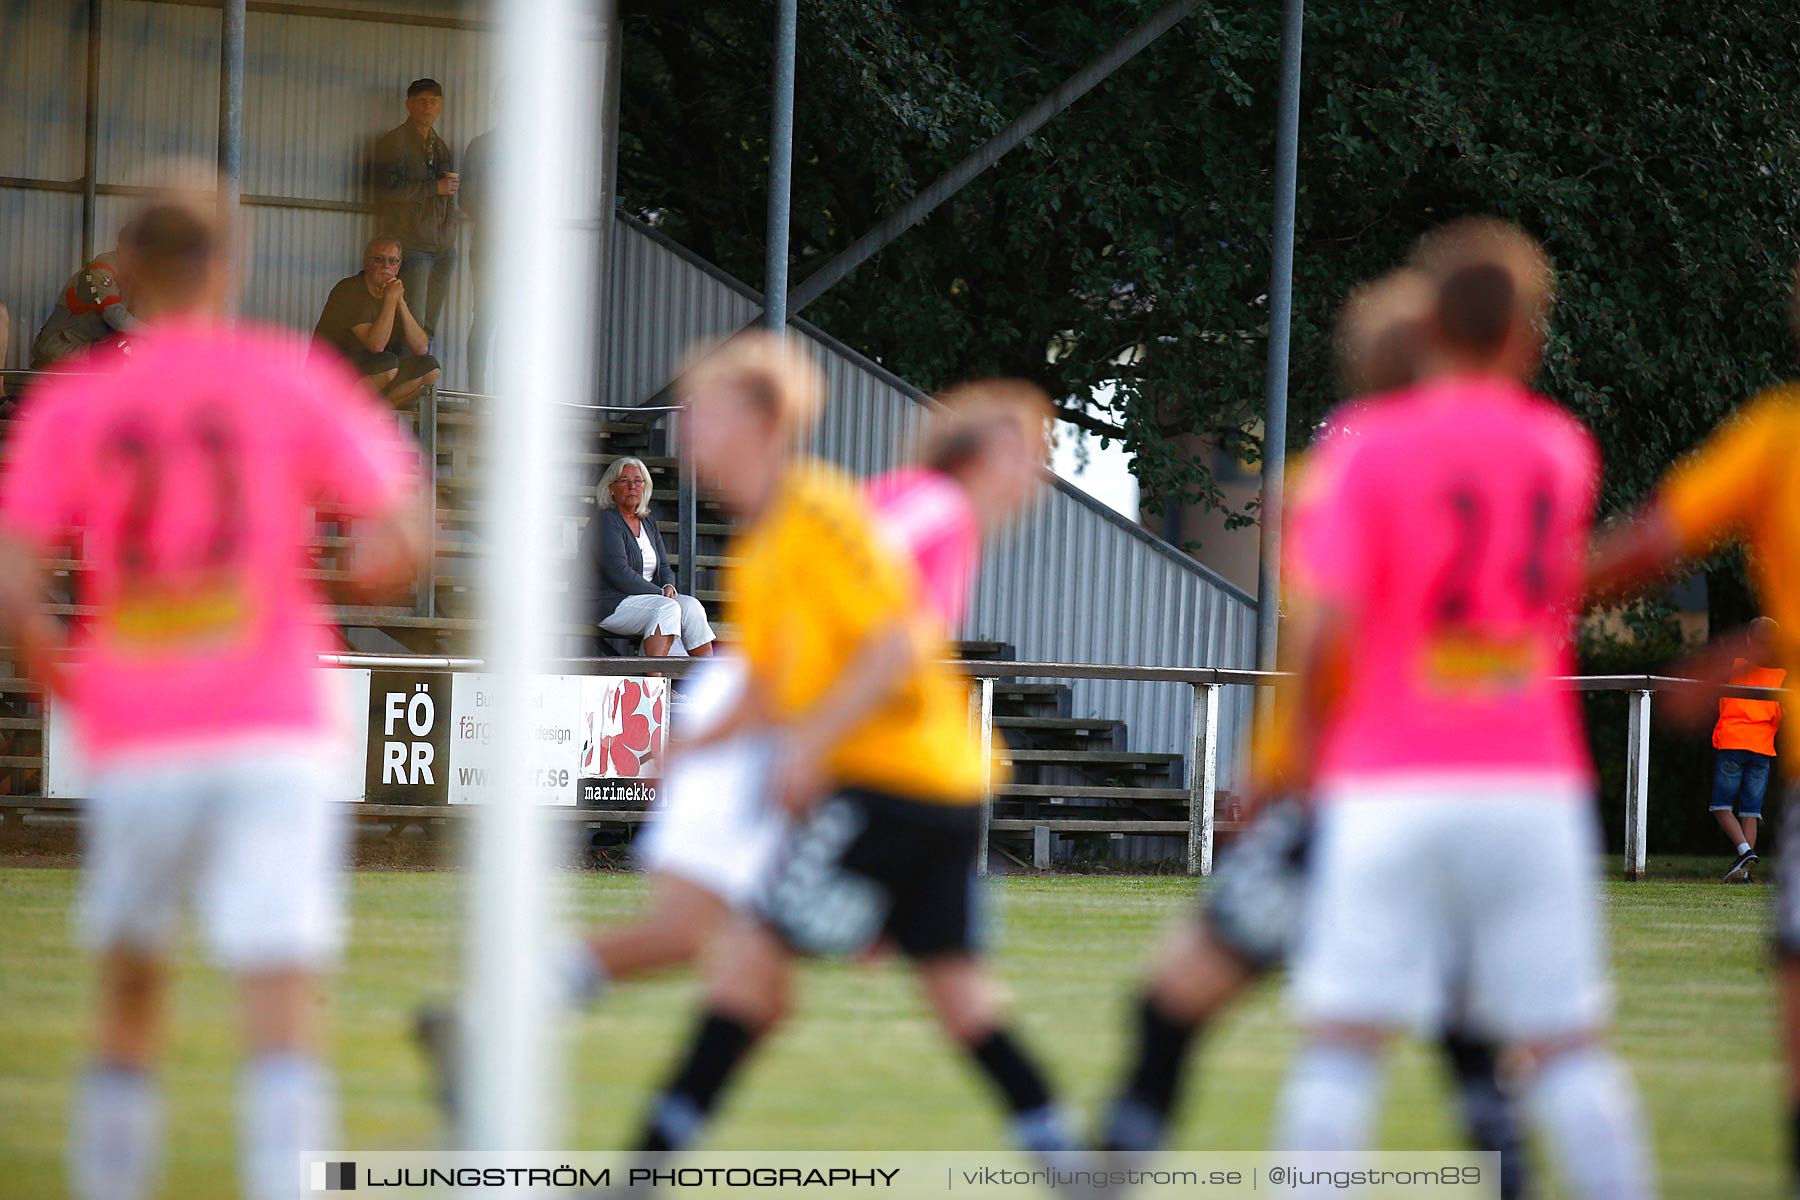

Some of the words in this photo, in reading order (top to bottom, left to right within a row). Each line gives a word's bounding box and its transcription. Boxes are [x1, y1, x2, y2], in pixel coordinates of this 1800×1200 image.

[384, 683, 435, 737] FÖ
[382, 741, 435, 785] RR
[584, 781, 656, 802] marimekko
